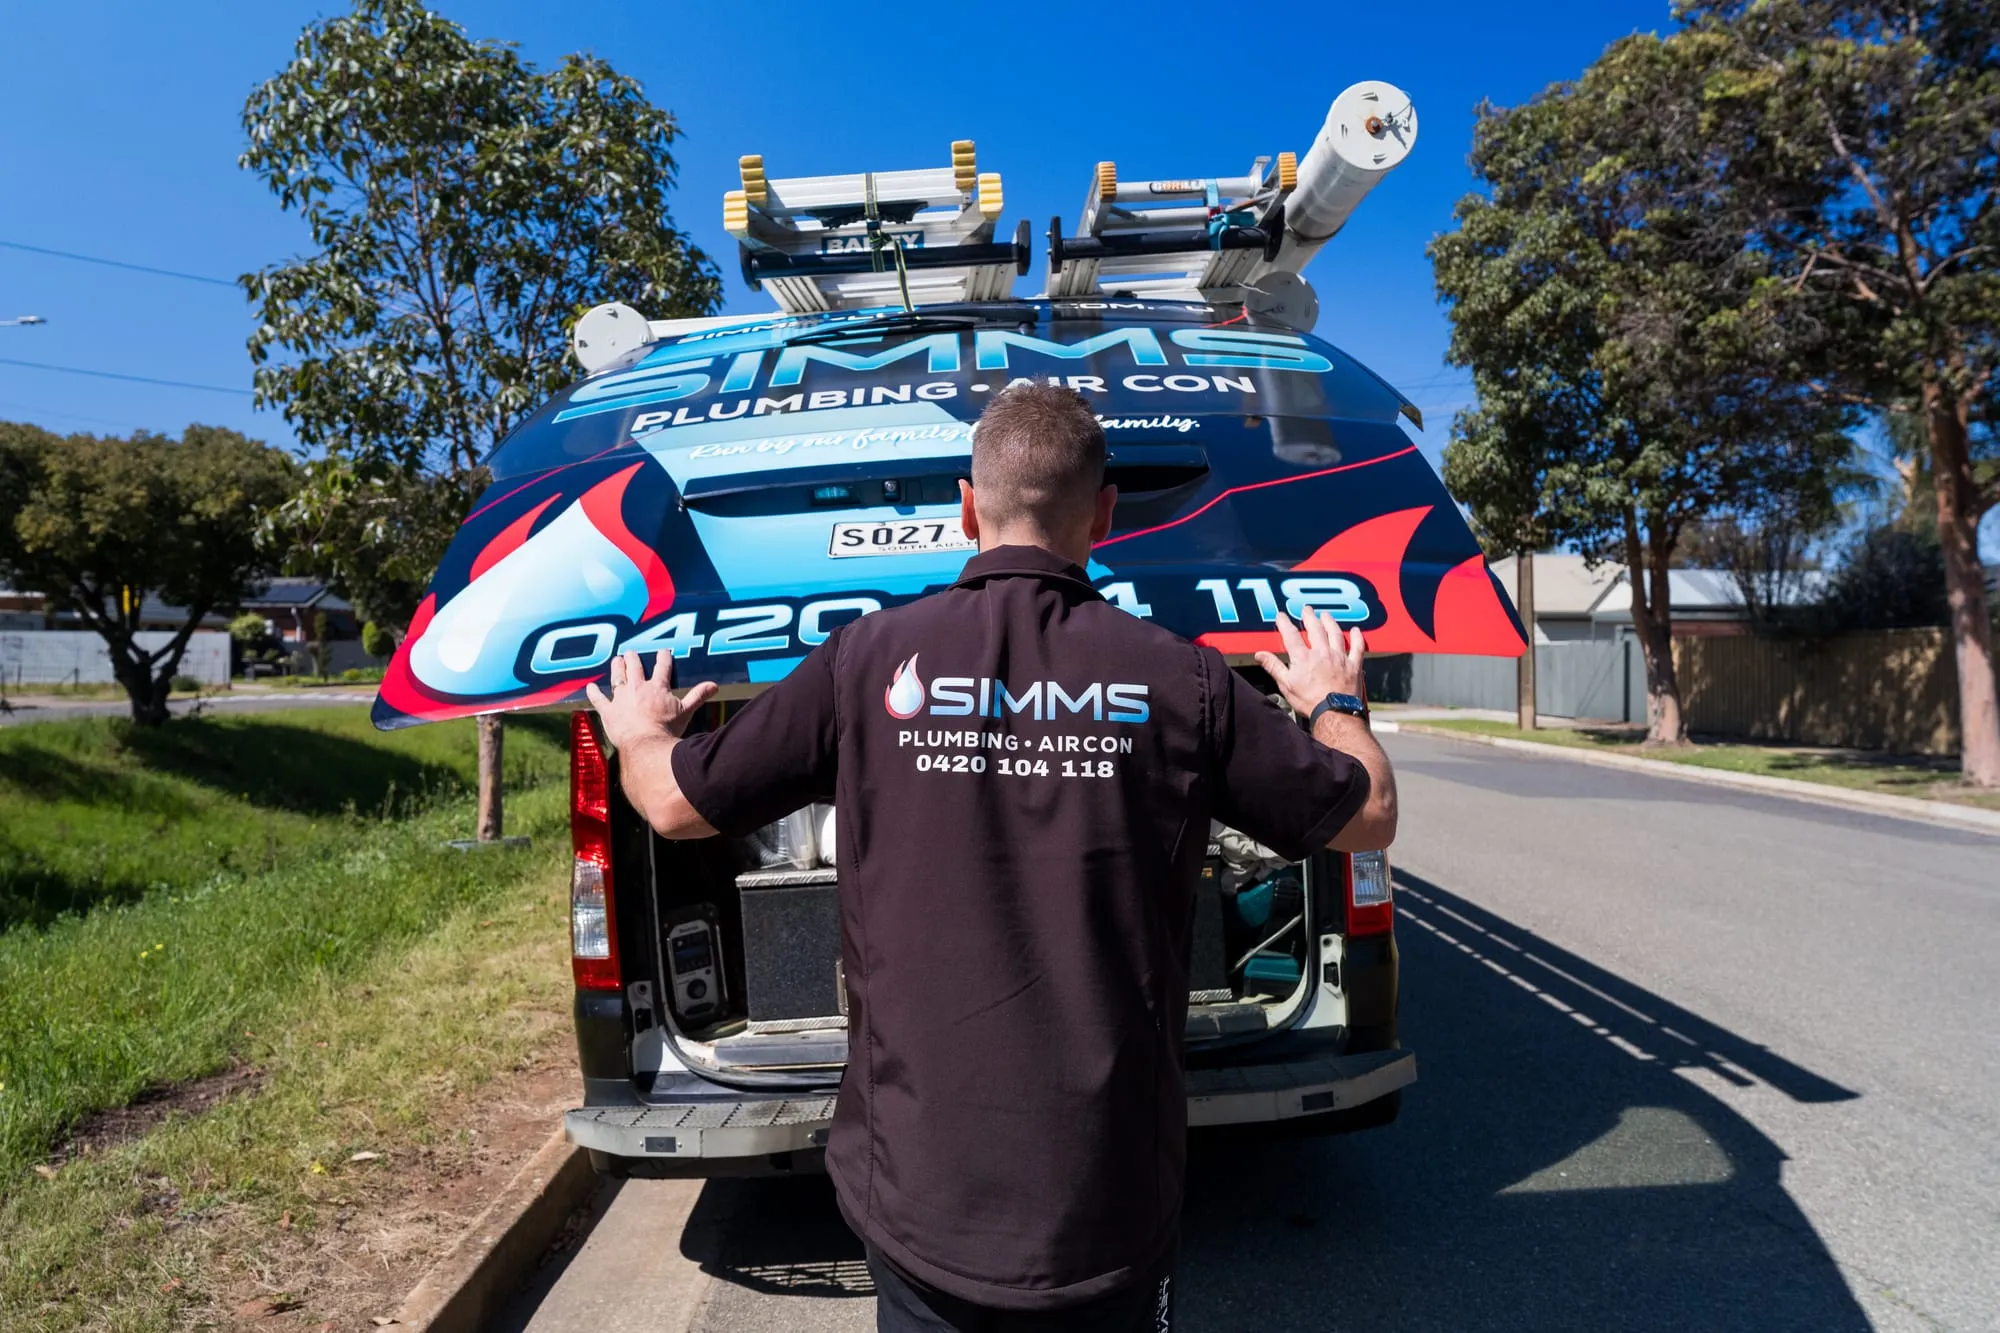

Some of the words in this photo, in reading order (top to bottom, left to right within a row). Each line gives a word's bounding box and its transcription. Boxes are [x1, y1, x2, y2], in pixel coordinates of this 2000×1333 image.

[552, 327, 1333, 424] SIMMS
[630, 381, 957, 432] PLUMBING
[1122, 374, 1257, 393] CON
[690, 442, 752, 459] Run
[756, 436, 794, 454] by
[801, 433, 842, 447] our
[878, 544, 928, 552] SOUTH
[1195, 577, 1370, 623] 118
[929, 676, 1150, 723] SIMMS
[898, 730, 1019, 751] PLUMBING
[1037, 735, 1133, 754] AIRCON
[915, 753, 987, 773] 0420
[997, 757, 1050, 777] 104
[1060, 759, 1115, 778] 118
